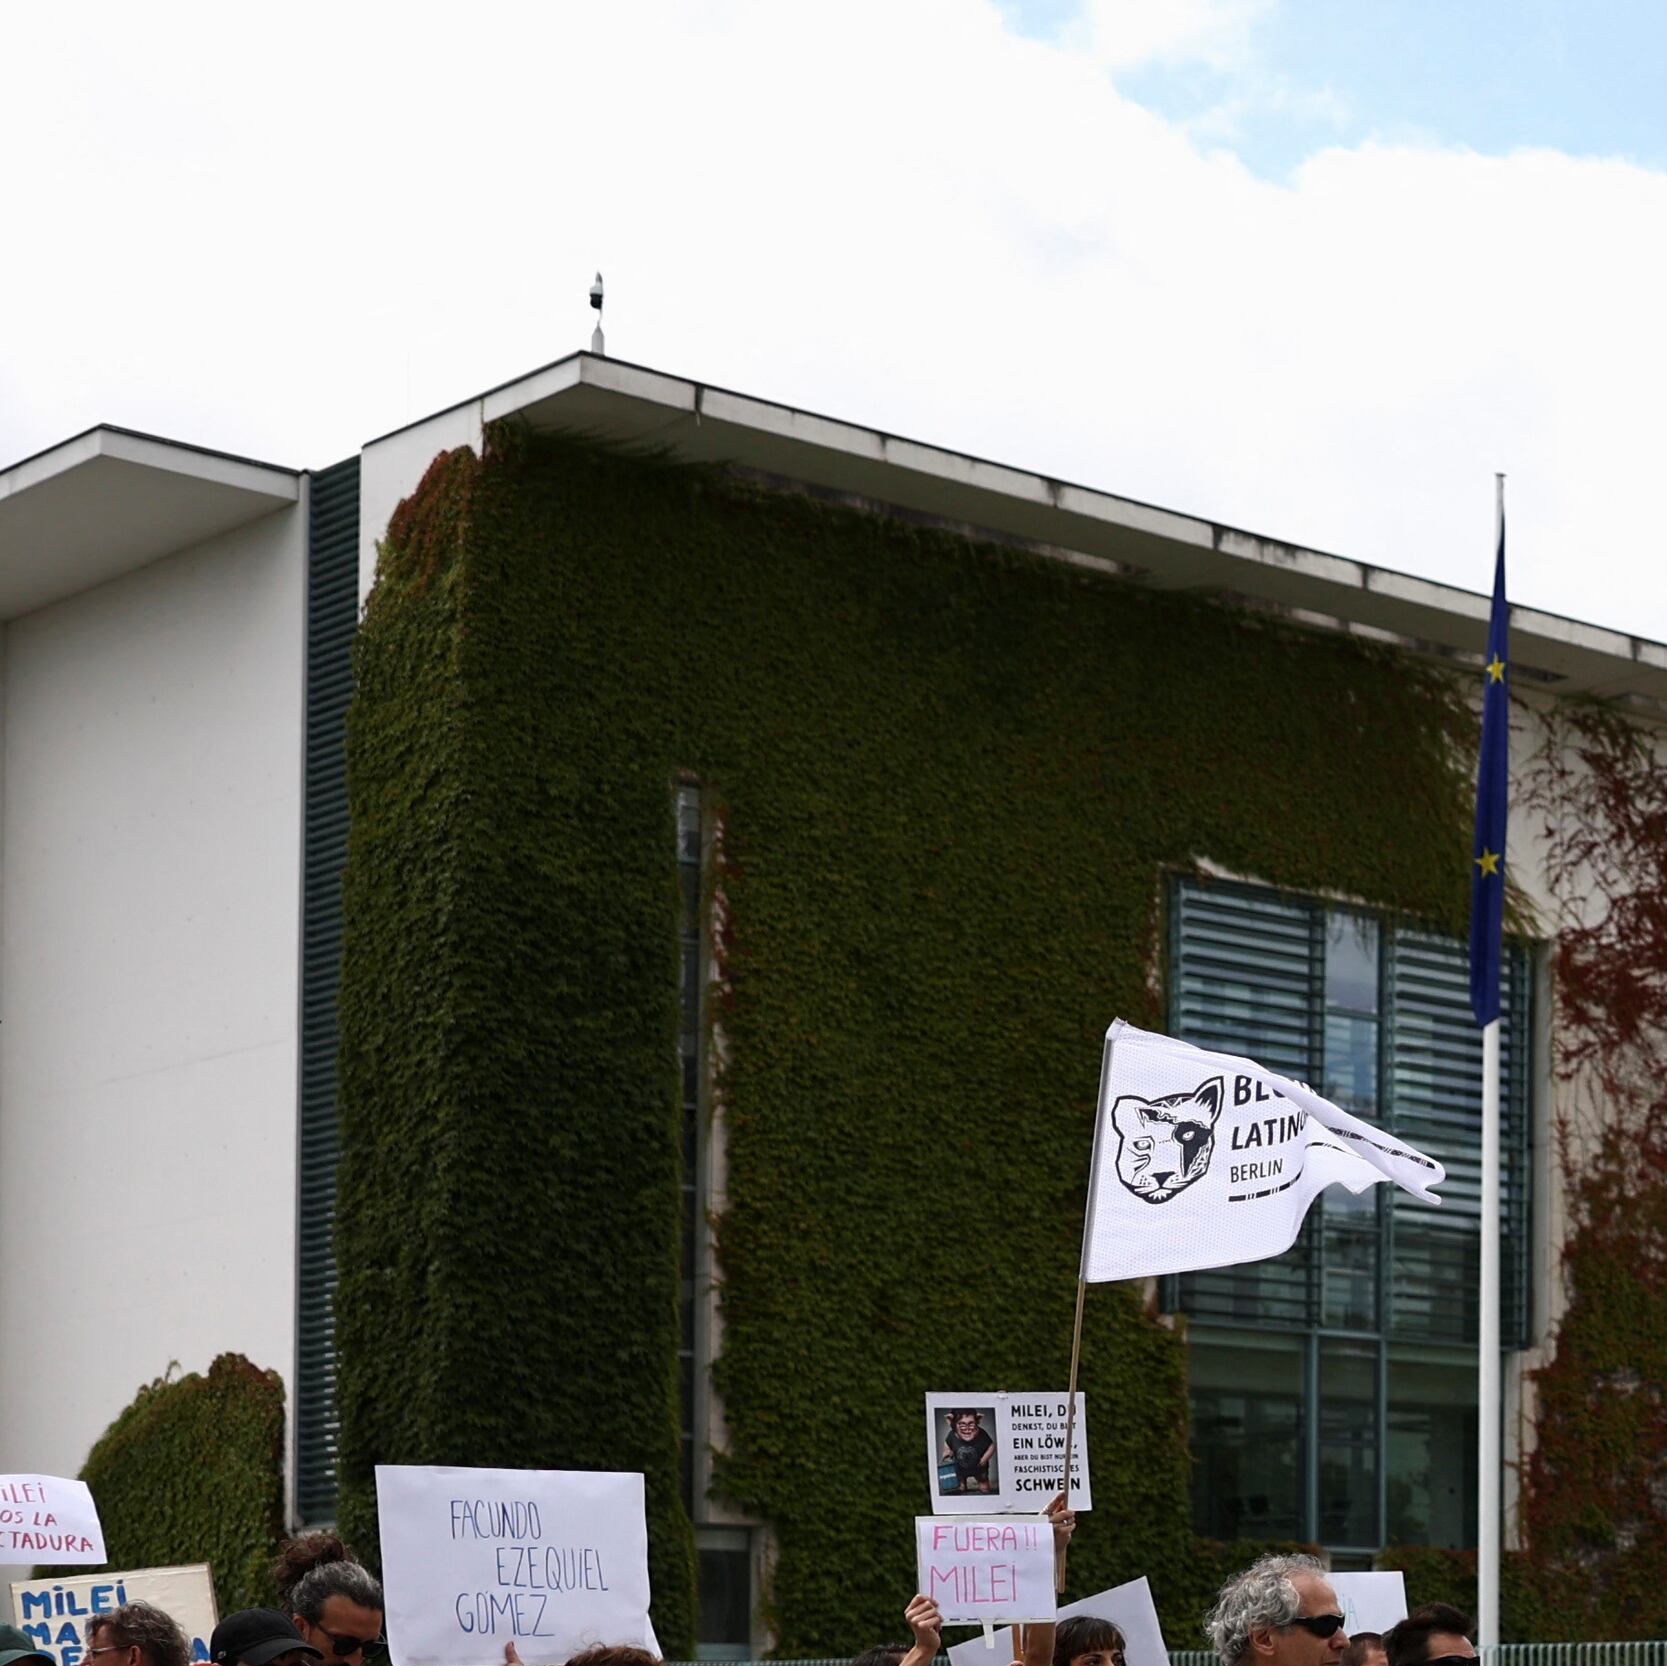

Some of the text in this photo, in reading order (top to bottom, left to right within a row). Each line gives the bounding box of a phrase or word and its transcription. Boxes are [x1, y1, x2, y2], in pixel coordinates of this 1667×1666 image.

[1230, 1158, 1283, 1184] BERLIN
[1011, 1405, 1052, 1418] MILEI,
[1012, 1423, 1044, 1431] DENKST,
[1013, 1434, 1078, 1449] EIN LÖW,
[1014, 1464, 1080, 1473] FASCHISTISCES
[1016, 1478, 1081, 1492] SCHWEN
[33, 1511, 58, 1528] LA
[450, 1499, 542, 1540] FACUNDO
[455, 1590, 555, 1637] GÓMEZ
